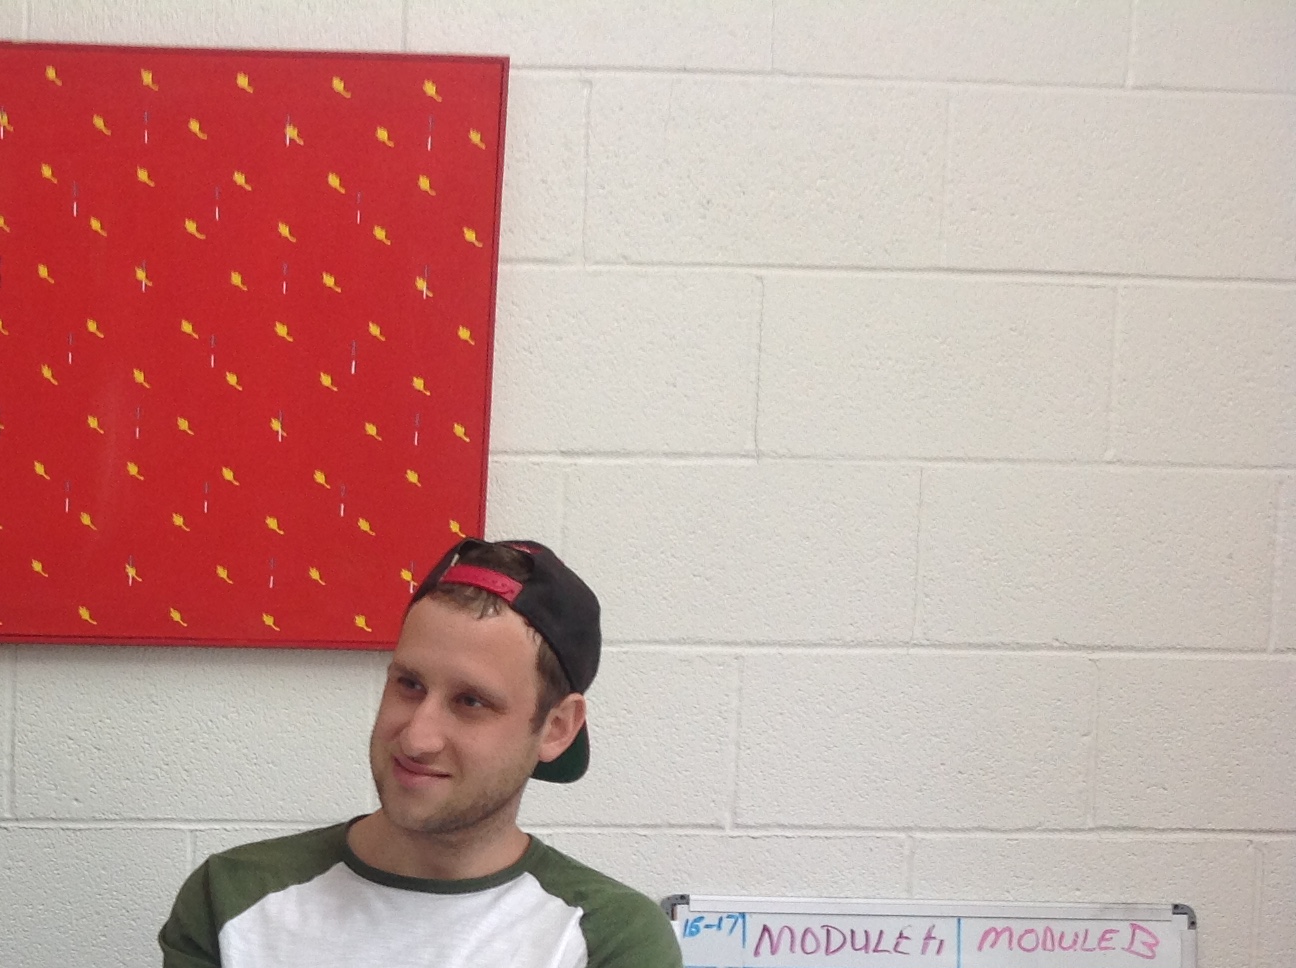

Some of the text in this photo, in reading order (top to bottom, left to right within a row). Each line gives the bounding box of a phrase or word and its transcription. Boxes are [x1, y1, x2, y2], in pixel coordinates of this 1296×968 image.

[754, 923, 912, 957] MODULE
[977, 922, 1160, 959] MODULE B
